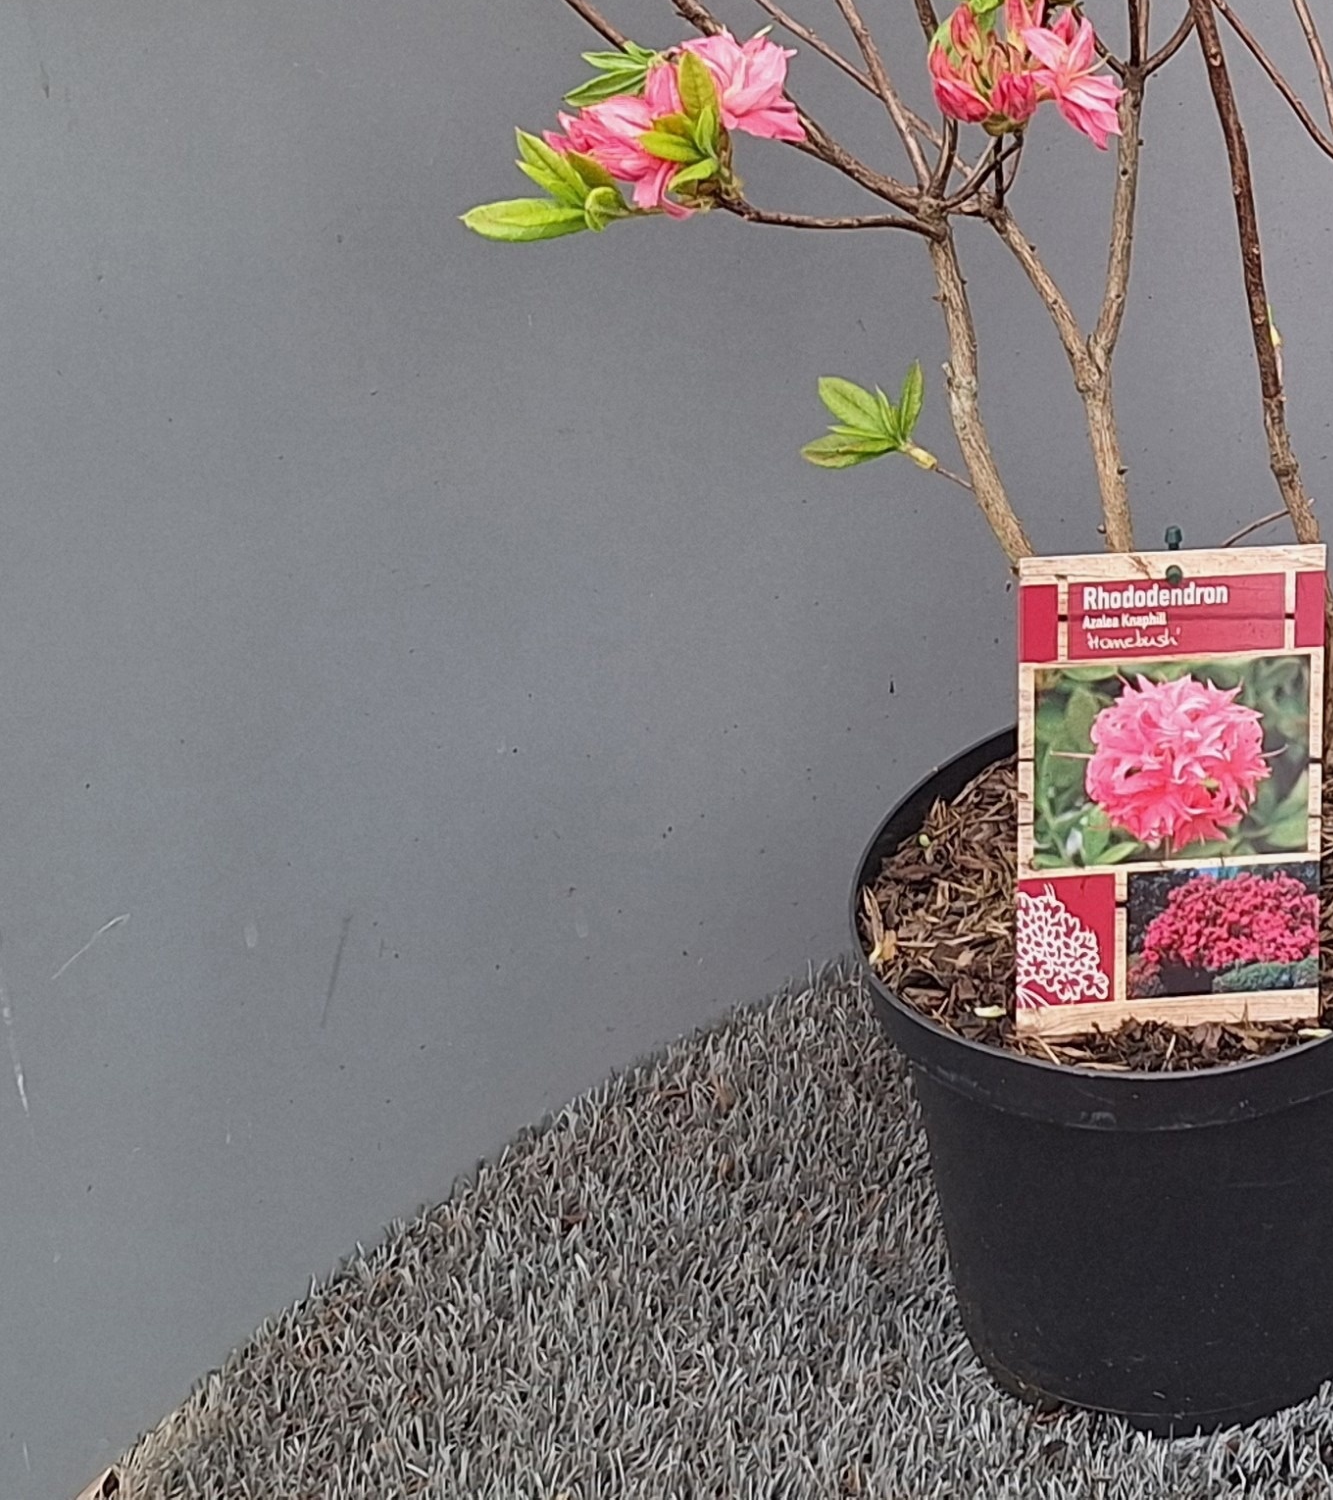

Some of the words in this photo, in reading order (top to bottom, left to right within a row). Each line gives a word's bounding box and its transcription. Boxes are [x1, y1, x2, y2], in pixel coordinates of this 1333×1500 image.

[1083, 581, 1229, 611] Rhododendron
[1082, 614, 1120, 630] Azalea
[1121, 611, 1168, 630] Knaphill
